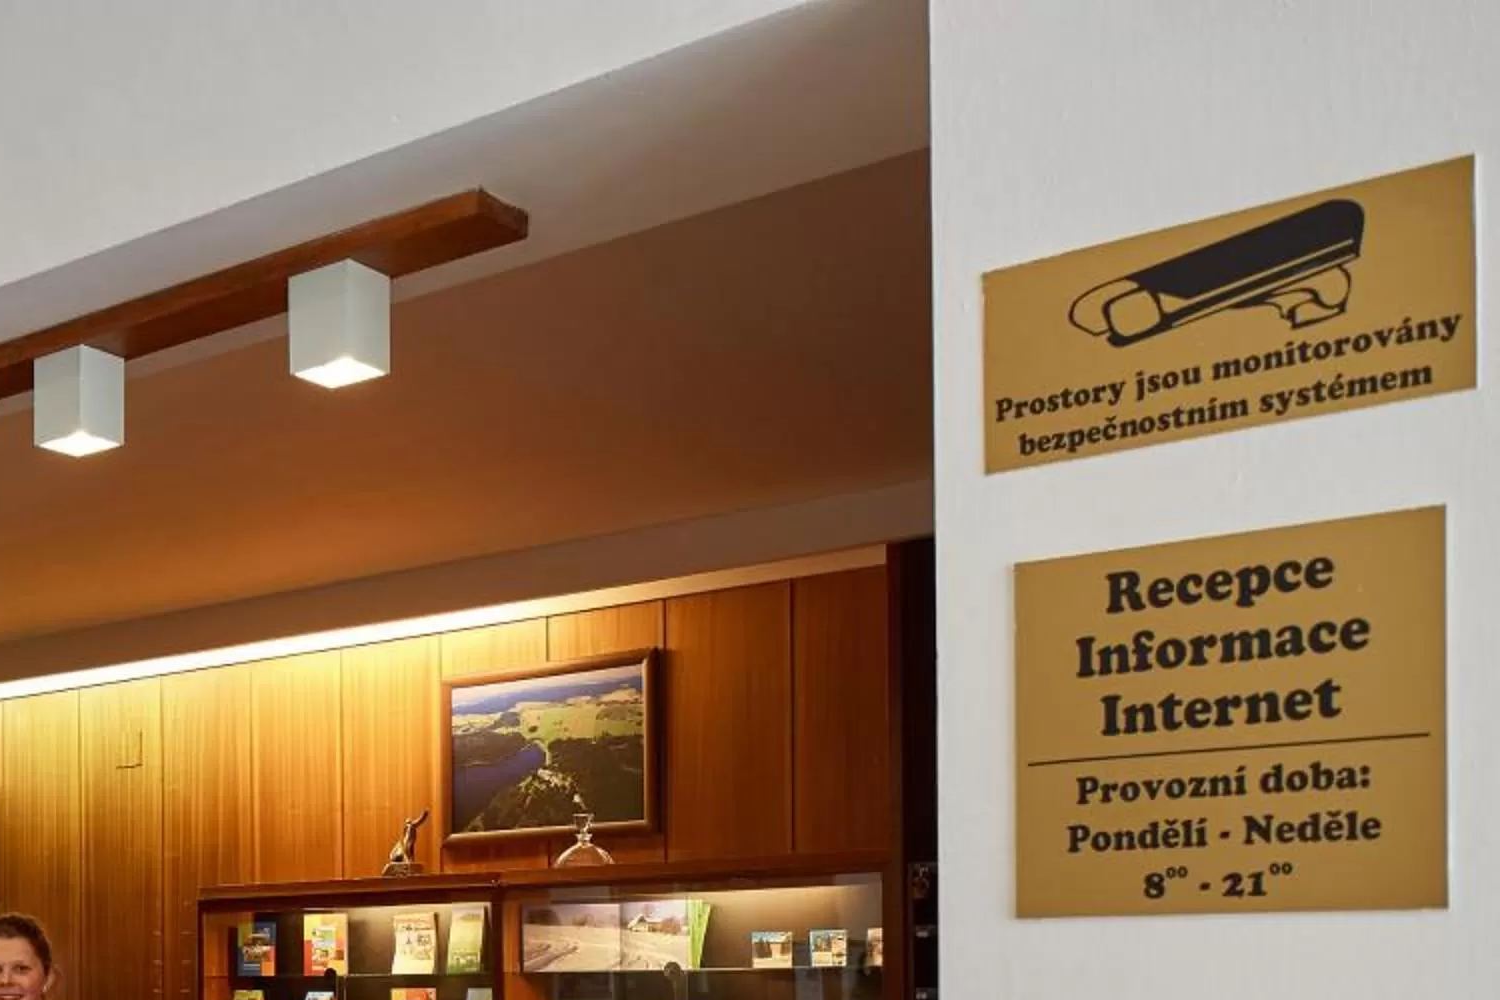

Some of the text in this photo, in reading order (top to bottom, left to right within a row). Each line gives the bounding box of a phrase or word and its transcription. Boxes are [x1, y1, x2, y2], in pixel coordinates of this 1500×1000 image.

[994, 313, 1463, 422] Prostory jsou monitorovány
[1018, 364, 1433, 456] bezpečnostním systémem
[1105, 556, 1335, 615] Recepce
[1075, 616, 1370, 678] Informace
[1100, 678, 1342, 737] Internet
[1075, 760, 1371, 805] Provozní doba:
[1067, 817, 1208, 853] Pondělí
[1242, 810, 1382, 846] Neděle
